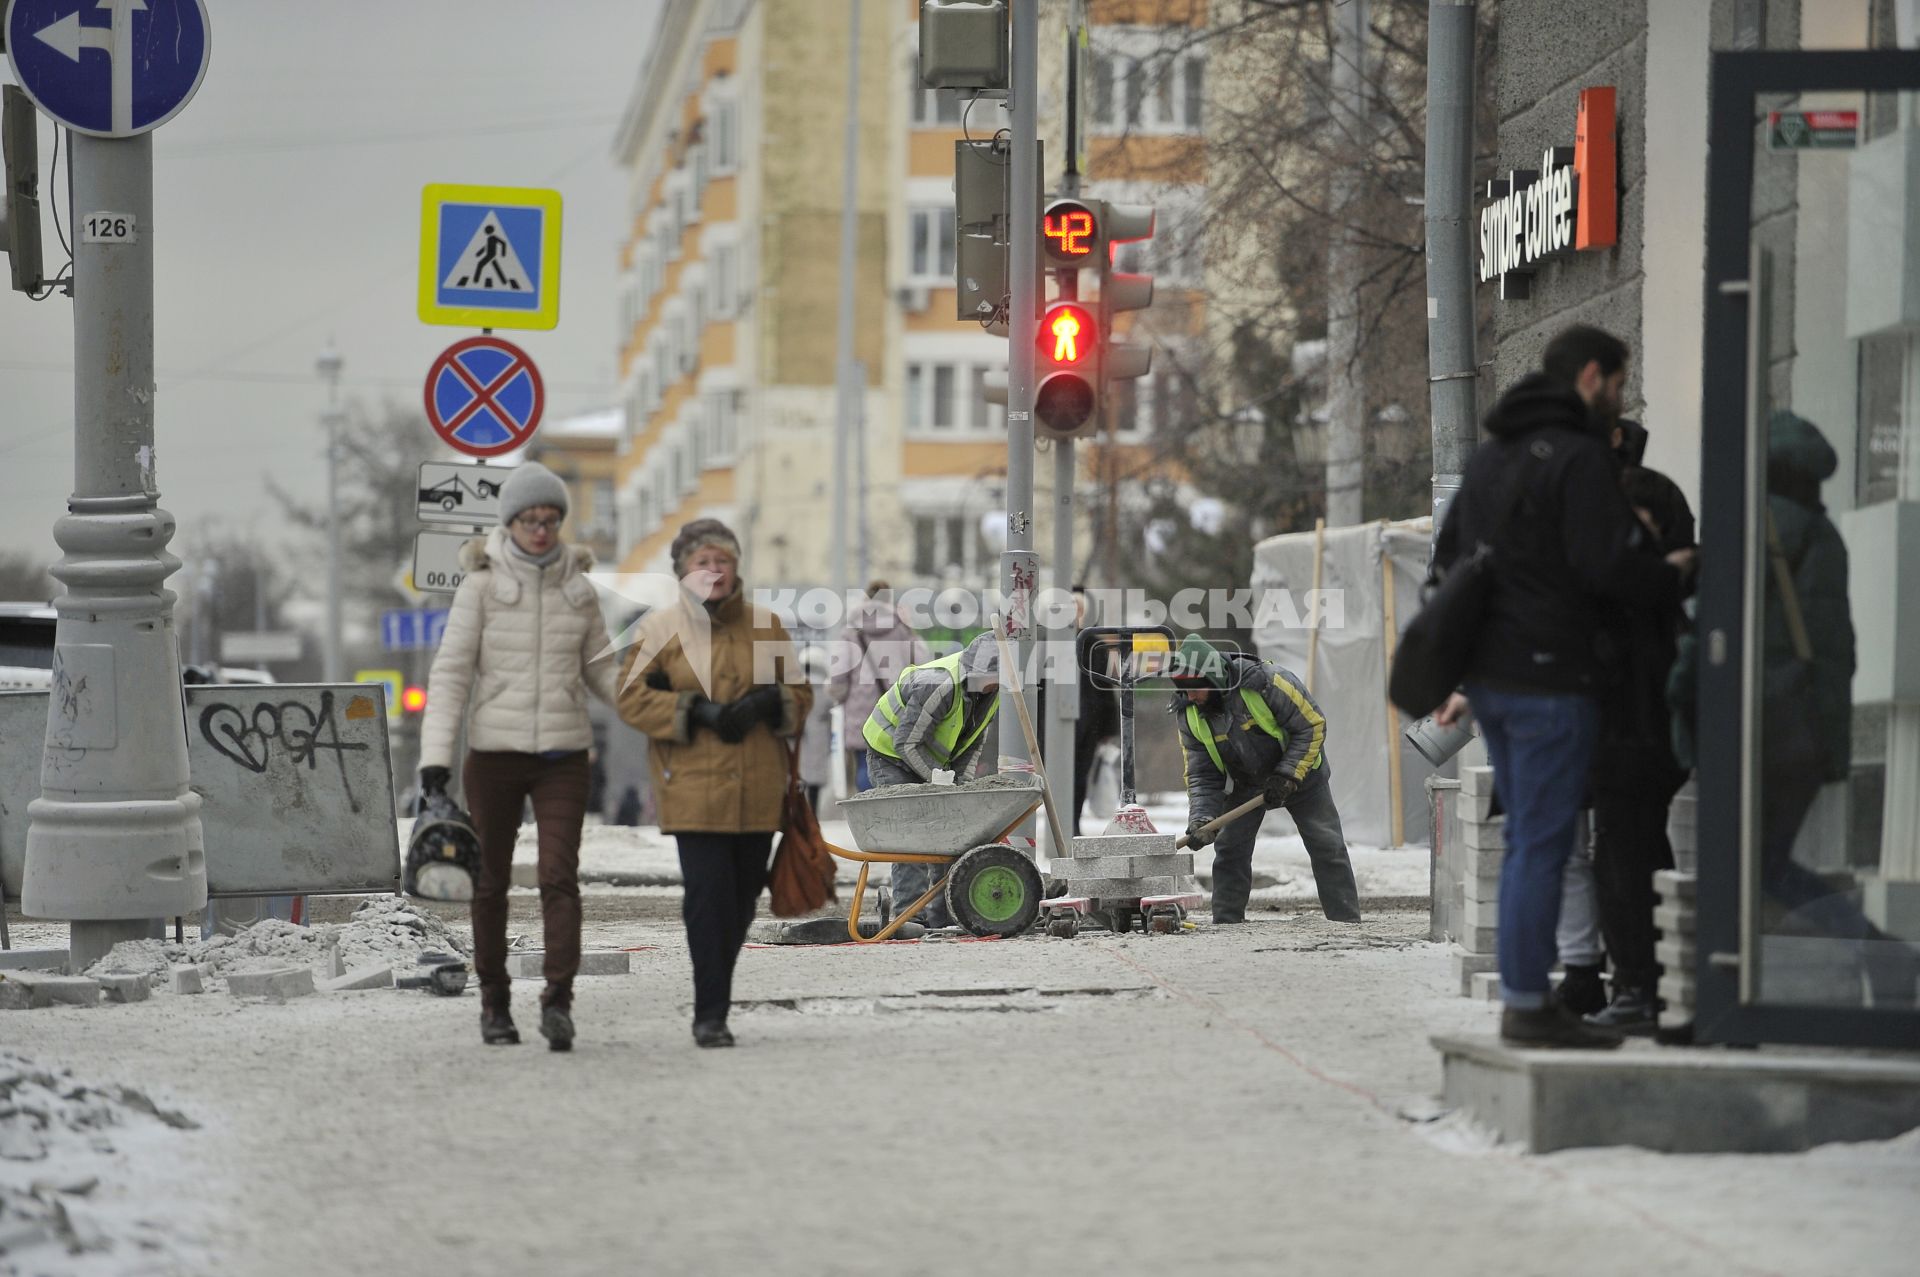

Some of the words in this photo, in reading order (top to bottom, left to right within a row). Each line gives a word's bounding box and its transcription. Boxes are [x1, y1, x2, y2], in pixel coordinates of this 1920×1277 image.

[88, 218, 126, 237] 126
[1043, 212, 1092, 253] 42
[1479, 170, 1522, 300] simple
[1525, 147, 1571, 263] coffee
[427, 572, 465, 588] 00.0
